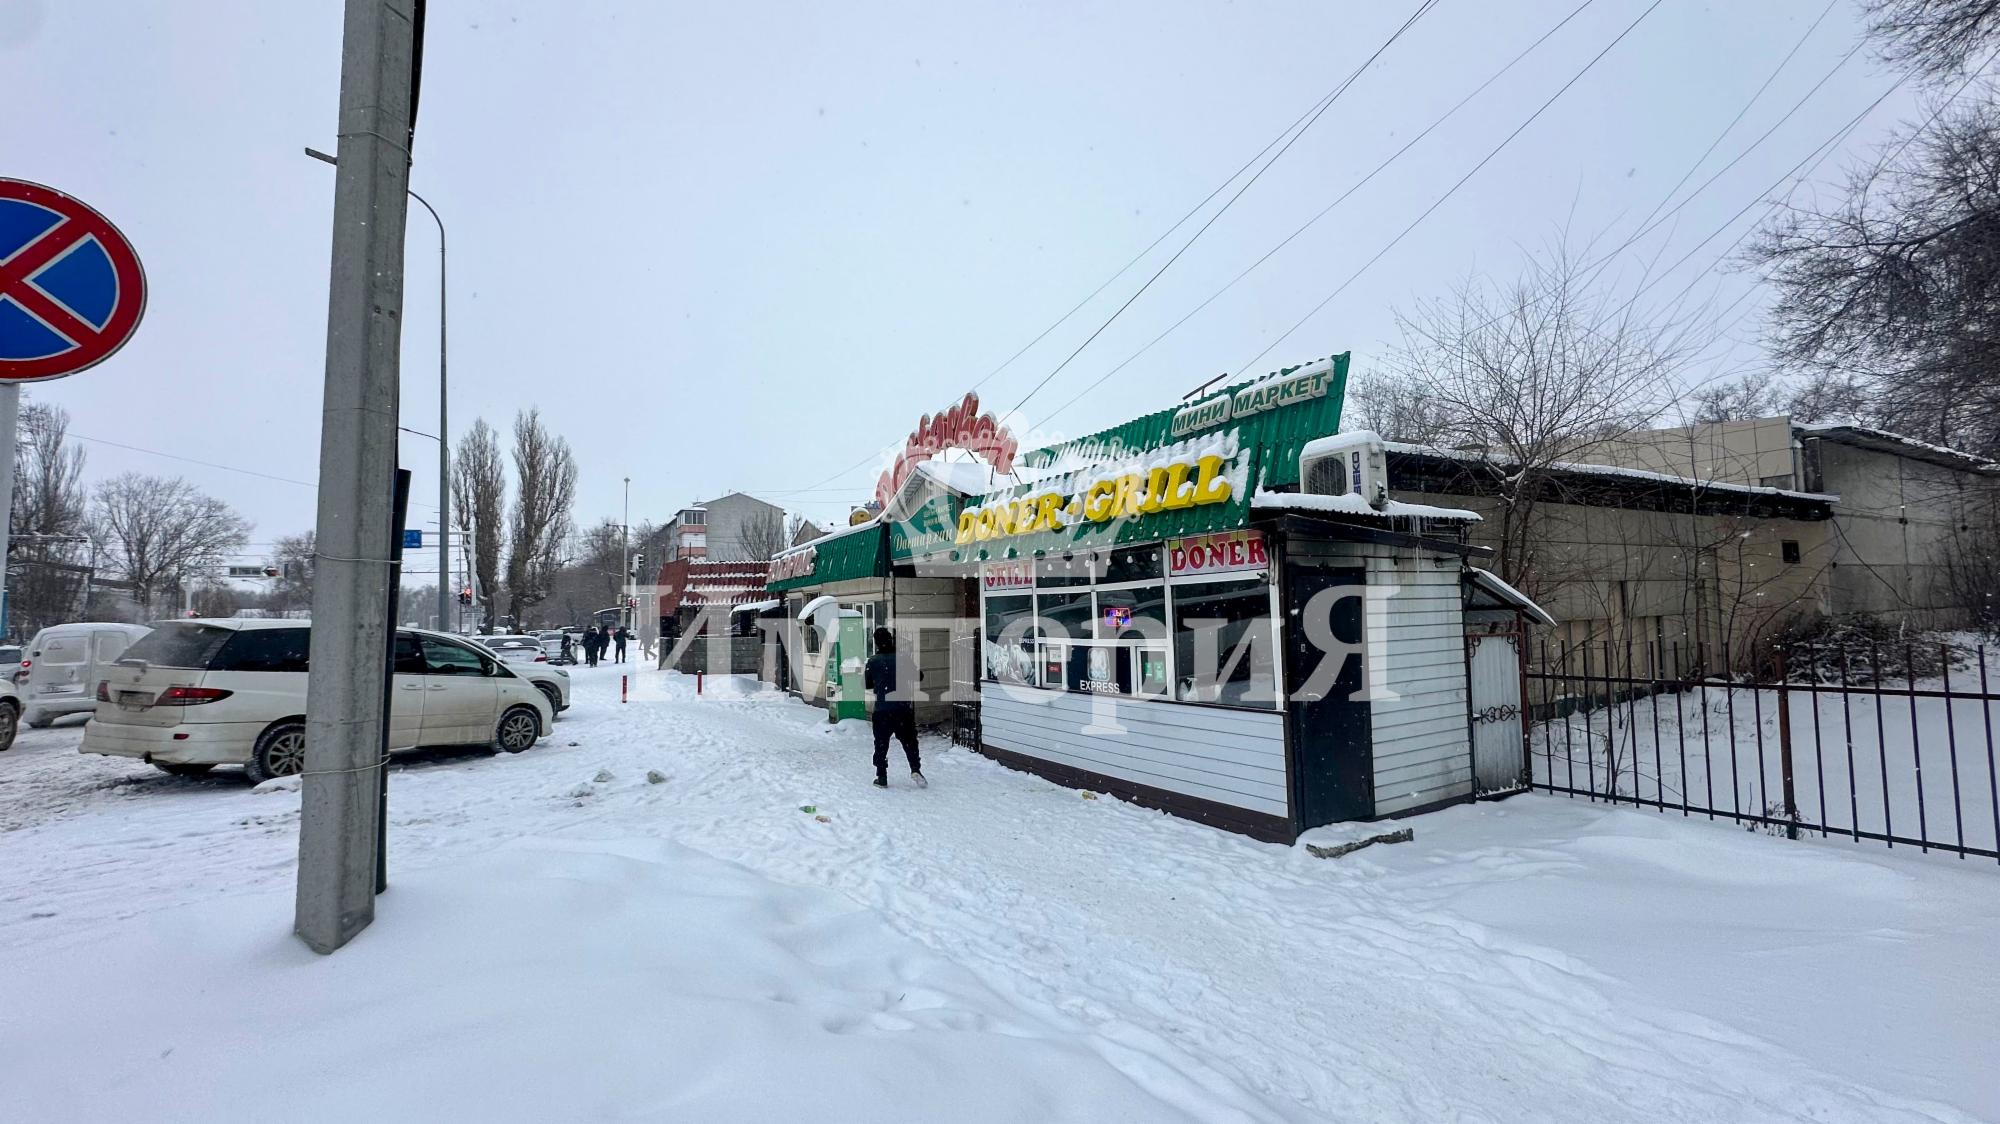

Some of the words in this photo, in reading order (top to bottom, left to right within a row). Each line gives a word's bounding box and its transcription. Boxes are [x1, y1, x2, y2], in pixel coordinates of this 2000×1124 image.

[1172, 401, 1226, 433] МИНИ
[1233, 372, 1328, 414] МАРКЕТ
[954, 490, 1064, 545] DONER
[1084, 455, 1232, 523] GRILL
[1171, 539, 1268, 572] DONER
[984, 565, 1033, 588] GRILL
[1079, 680, 1120, 694] EXPRESS
